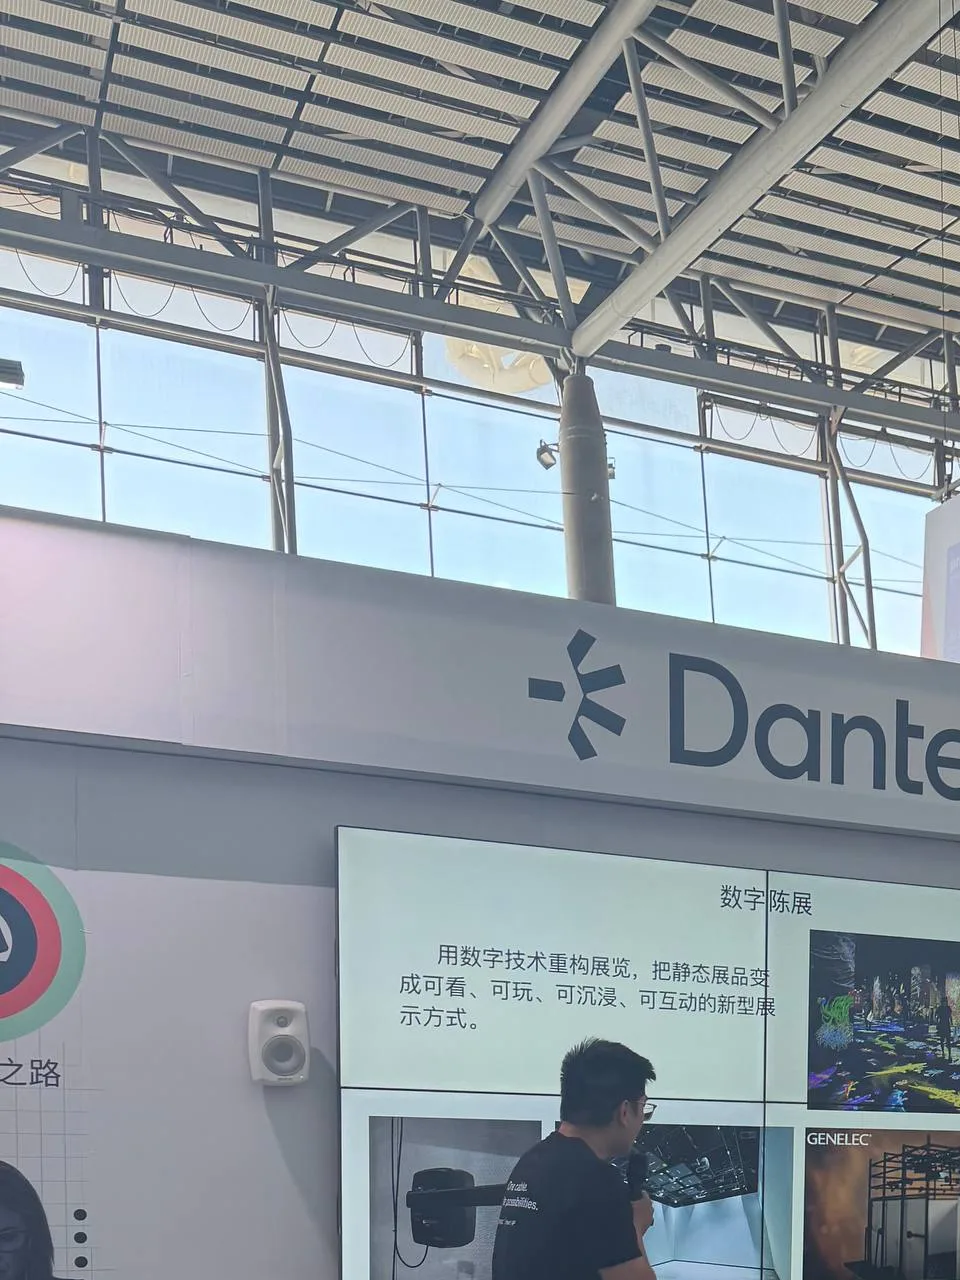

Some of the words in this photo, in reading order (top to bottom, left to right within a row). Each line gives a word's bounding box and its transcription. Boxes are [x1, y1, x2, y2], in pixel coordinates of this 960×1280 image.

[720, 884, 813, 916] 数字陈展
[437, 943, 771, 989] 用数字技术重构展览，把静态展品变
[399, 972, 777, 1018] 成可看、可玩、可沉浸、可互动的新型展
[399, 1003, 480, 1031] 示方式。
[0, 1057, 61, 1088] 之路
[807, 1132, 870, 1146] GENELEC
